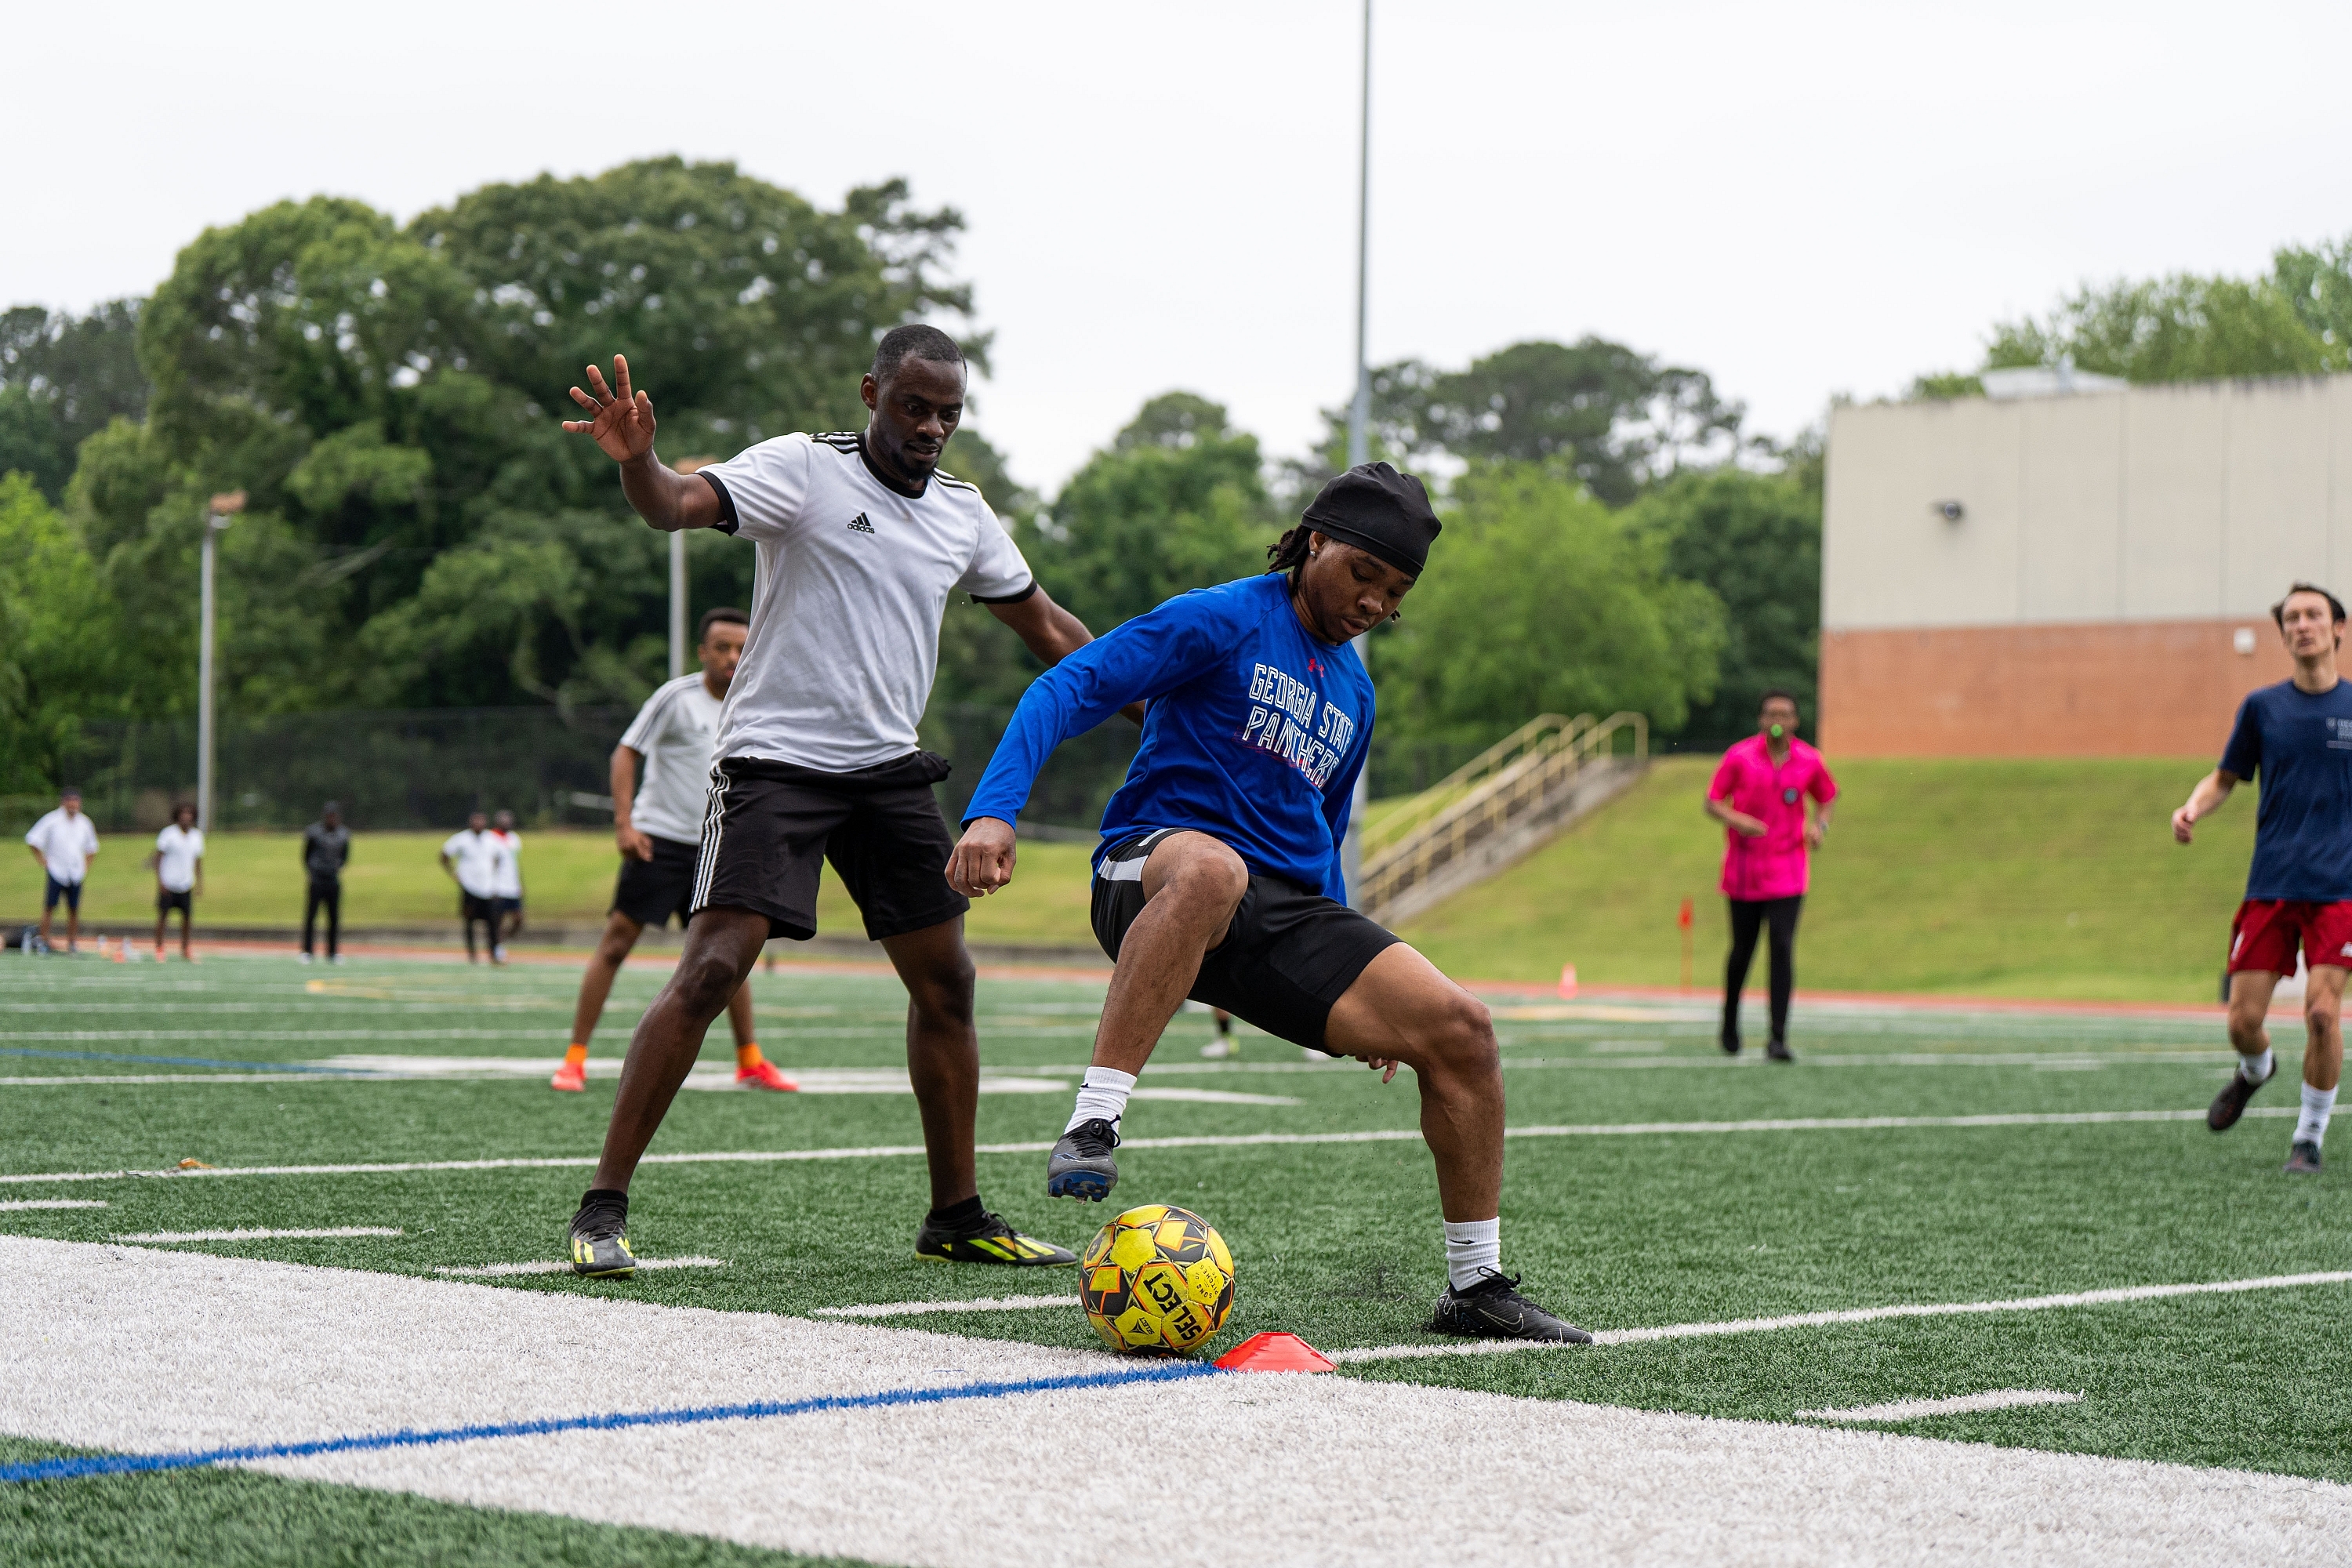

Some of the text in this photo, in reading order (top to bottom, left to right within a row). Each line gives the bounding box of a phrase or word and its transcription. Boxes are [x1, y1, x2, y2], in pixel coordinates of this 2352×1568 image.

[847, 523, 875, 534] adidas
[1249, 662, 1354, 757] GEORGIA STATE
[1242, 706, 1339, 788] PANTHERS
[1196, 1283, 1213, 1299] SONS
[1200, 1264, 1218, 1295] PITCHES
[1143, 1272, 1203, 1340] SELECT
[1139, 1317, 1155, 1334] SELECT
